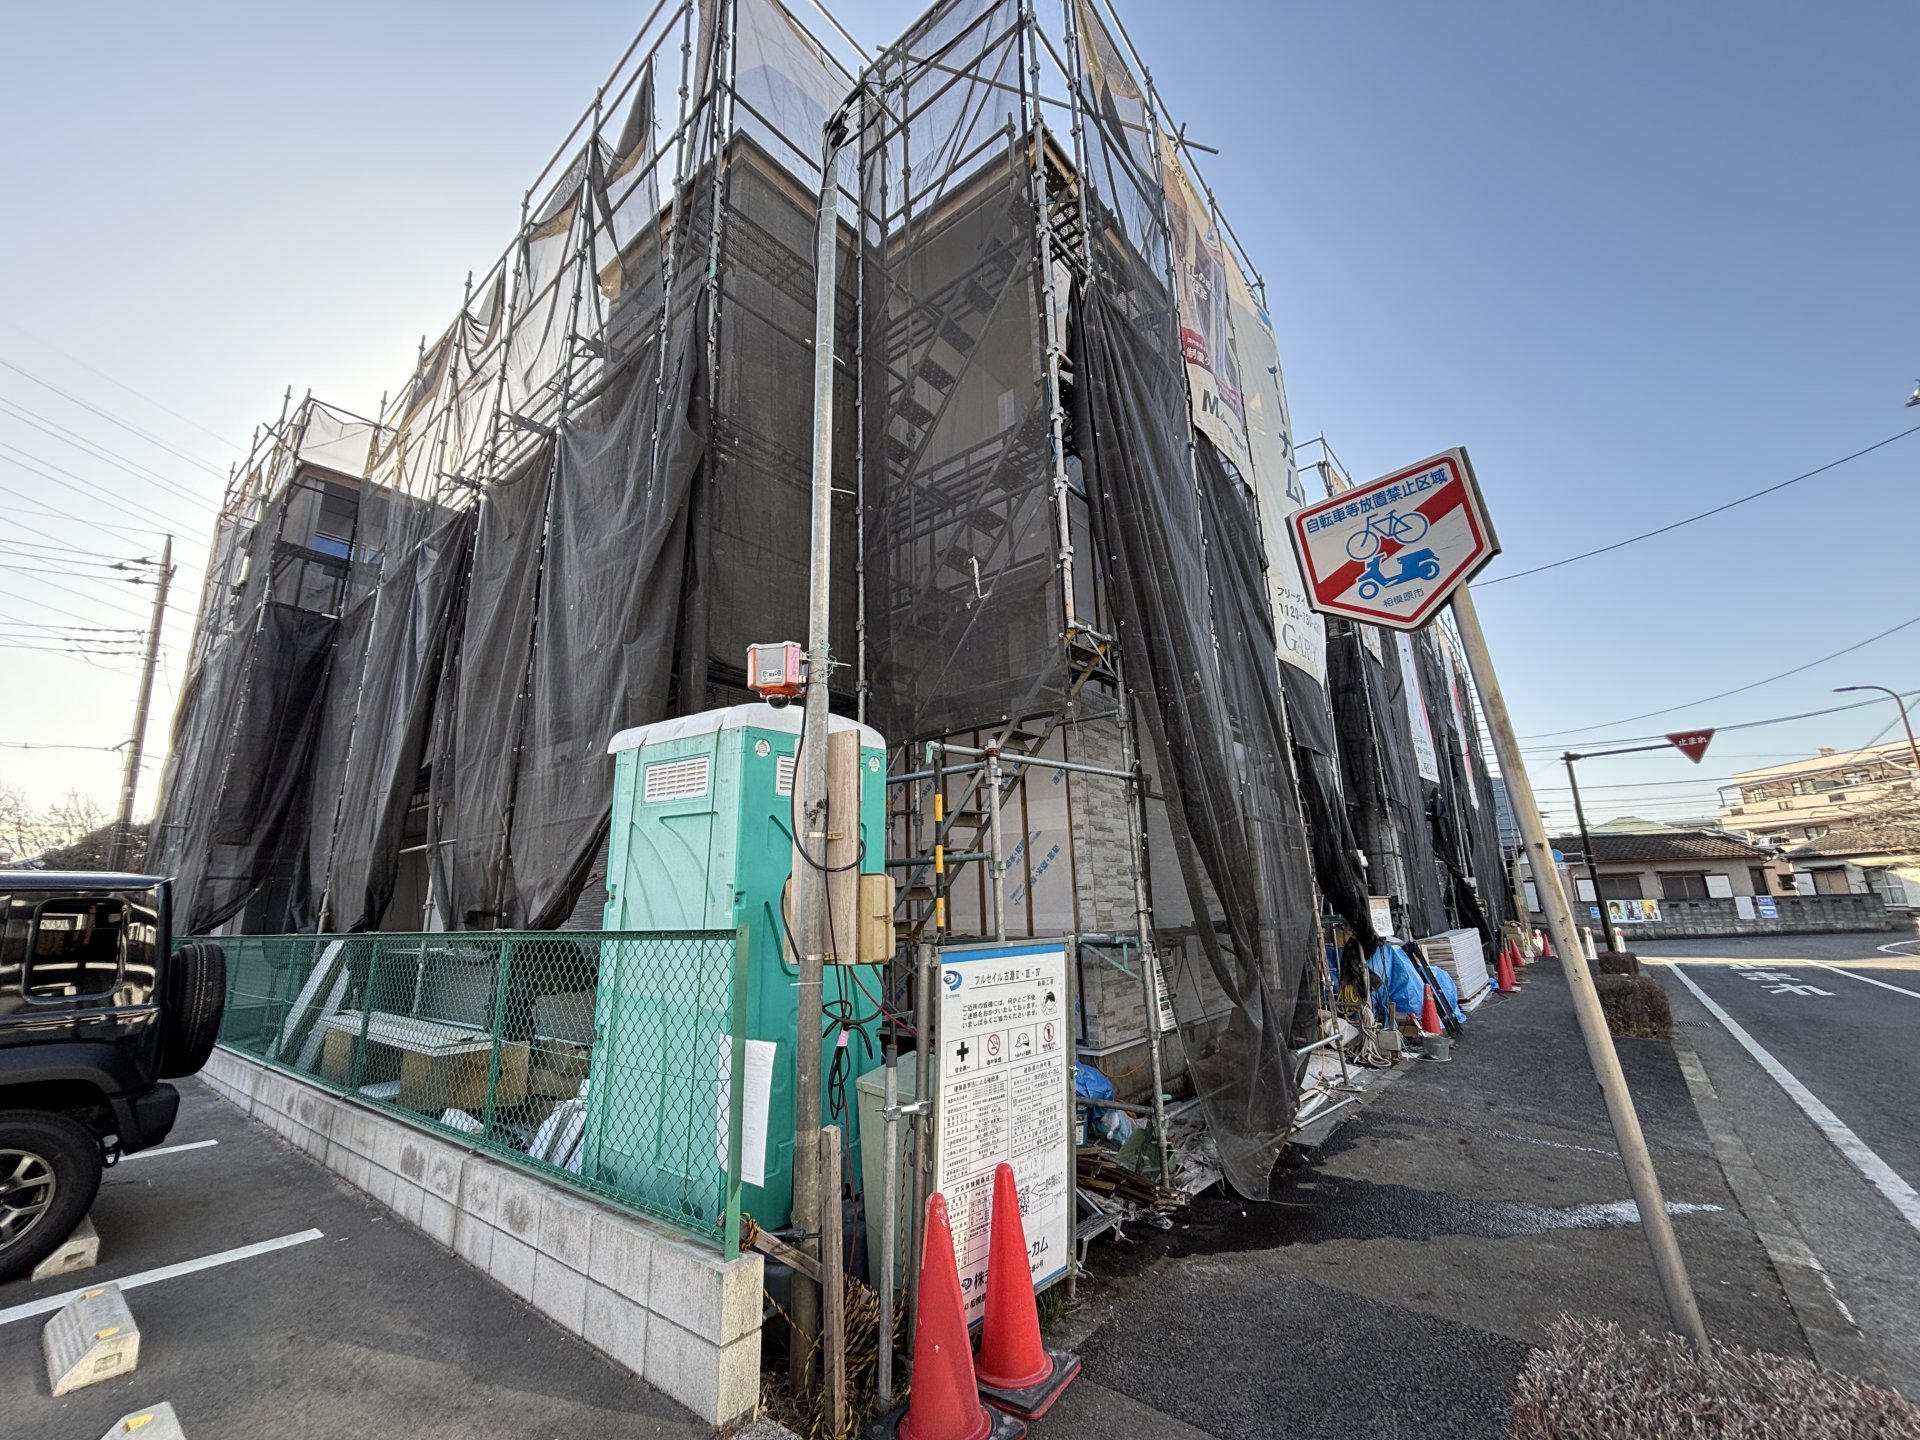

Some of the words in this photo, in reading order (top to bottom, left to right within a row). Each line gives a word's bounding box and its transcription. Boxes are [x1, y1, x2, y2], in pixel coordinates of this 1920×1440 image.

[1306, 467, 1448, 534] 自転車等放置禁止区域
[1383, 587, 1425, 608] 相模原市
[1679, 735, 1708, 747] 止まれ
[1729, 962, 1836, 996] 止まれ
